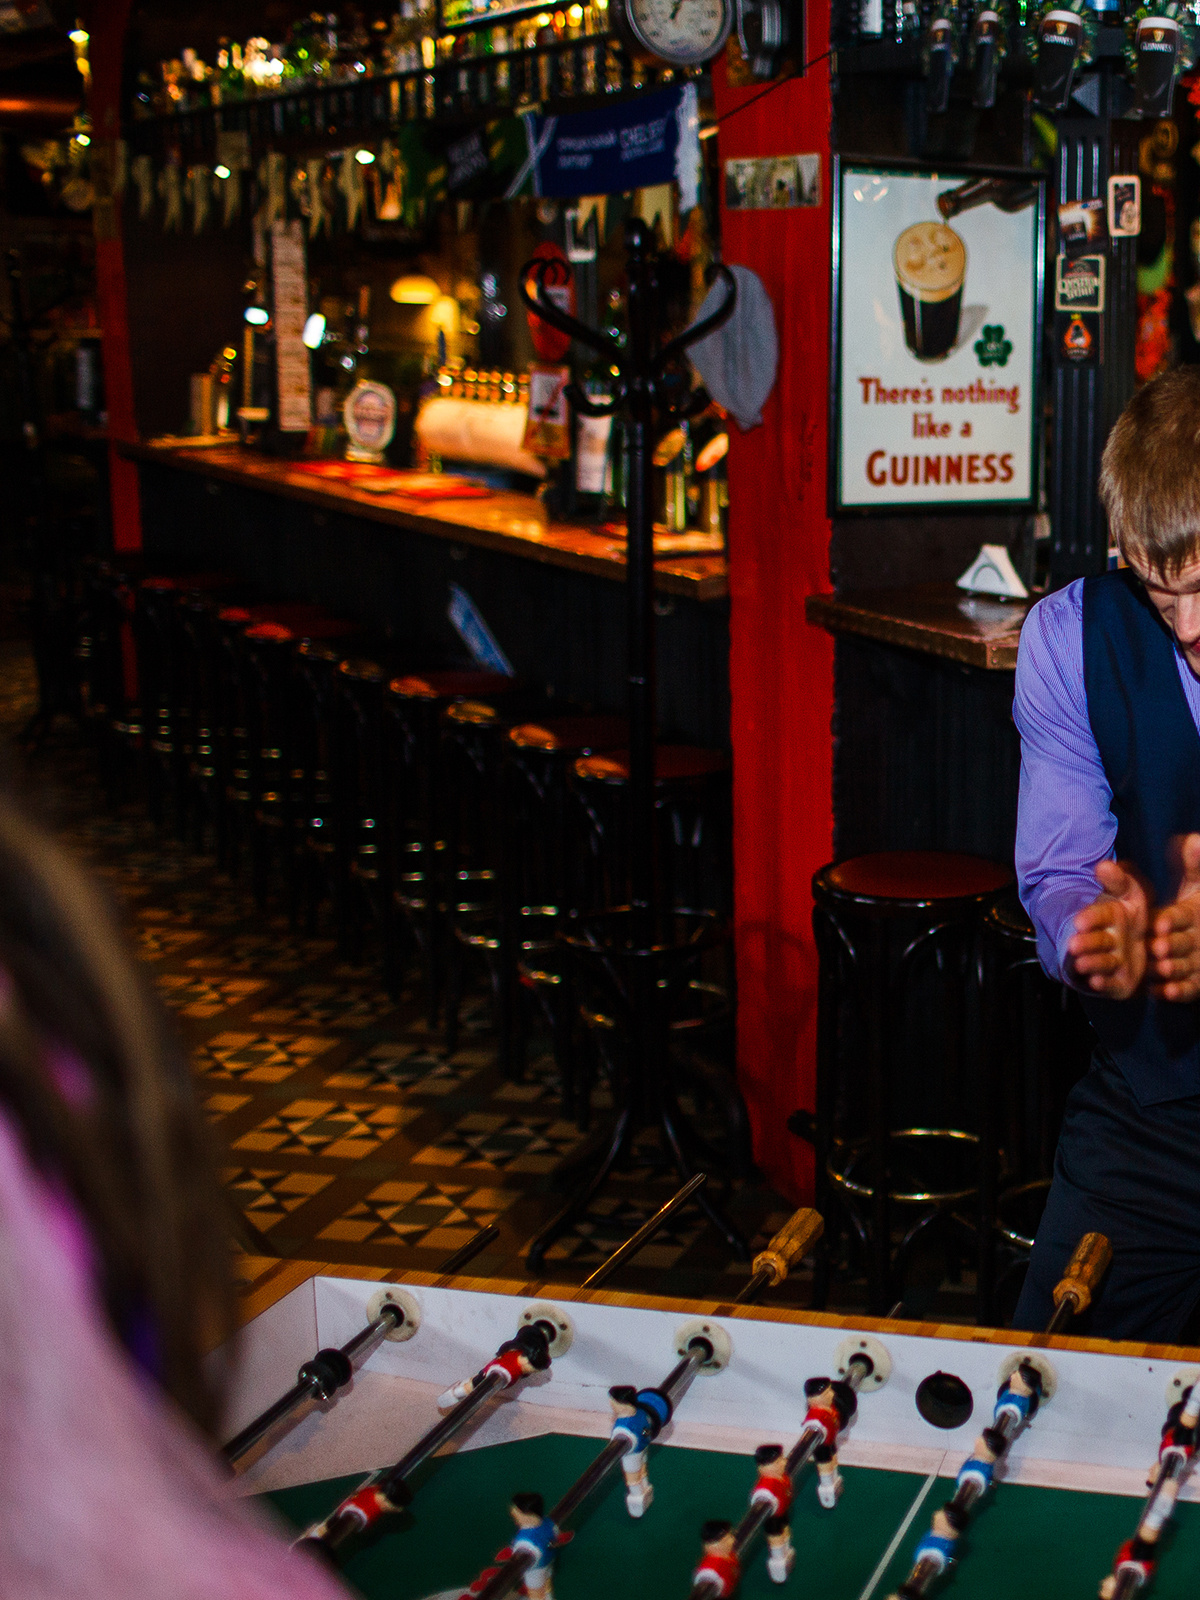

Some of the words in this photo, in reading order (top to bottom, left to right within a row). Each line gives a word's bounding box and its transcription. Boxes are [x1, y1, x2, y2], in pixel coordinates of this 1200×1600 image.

[858, 376, 934, 404] There's
[941, 377, 1021, 414] nothing
[912, 411, 951, 438] like
[959, 421, 973, 439] a
[866, 450, 1014, 487] GUINNESS
